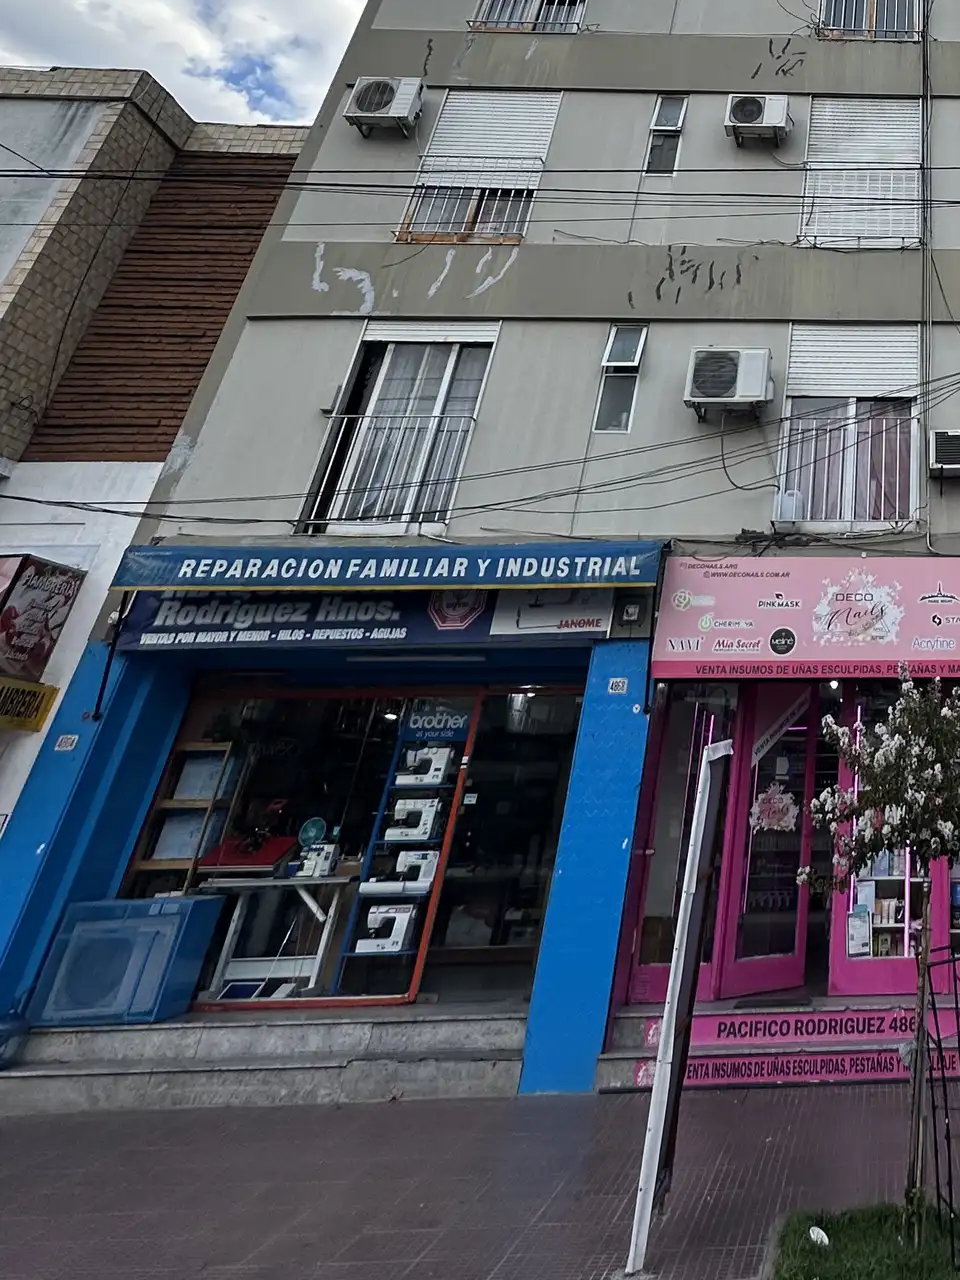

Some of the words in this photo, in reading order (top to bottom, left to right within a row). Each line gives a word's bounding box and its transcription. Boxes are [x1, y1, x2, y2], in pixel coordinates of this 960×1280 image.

[178, 558, 342, 578] REPARACION
[346, 557, 468, 578] FAMILIAR
[478, 558, 491, 577] Y
[496, 556, 640, 578] INDUSTRIAL
[758, 600, 777, 608] PINK
[777, 600, 801, 608] MASK
[835, 593, 874, 601] DECO
[153, 599, 311, 628] Rodriguez
[314, 596, 400, 622] Hnos.
[557, 618, 602, 629] JANOME
[174, 632, 194, 644] POR
[228, 631, 237, 643] Y
[237, 630, 270, 642] MENOR
[277, 629, 304, 641] HILOS
[311, 628, 364, 640] REPUESTOS
[370, 627, 407, 639] AGUJAS
[714, 639, 734, 649] Mia
[736, 639, 761, 649] Secret
[912, 637, 955, 650] Acryfine
[696, 665, 727, 675] VENTA
[729, 665, 774, 675] INSUMOS
[776, 665, 791, 674] DE
[793, 662, 819, 674] UÑAS
[822, 664, 884, 676] ESCULPIDAS,
[887, 662, 937, 674] PEAÑAS
[939, 665, 945, 673] Y
[410, 713, 468, 728] brother
[717, 1019, 791, 1039] PACIFICO
[794, 1016, 885, 1036] RODRIGUEZ
[888, 1016, 917, 1033] 486
[687, 1063, 710, 1080] ENTA
[711, 1060, 752, 1078] INSUMOS
[753, 1059, 765, 1076] DE
[766, 1056, 791, 1076] UÑAS
[792, 1056, 848, 1077] ESCULPIDAS,
[850, 1053, 894, 1074] PESTAÑAS
